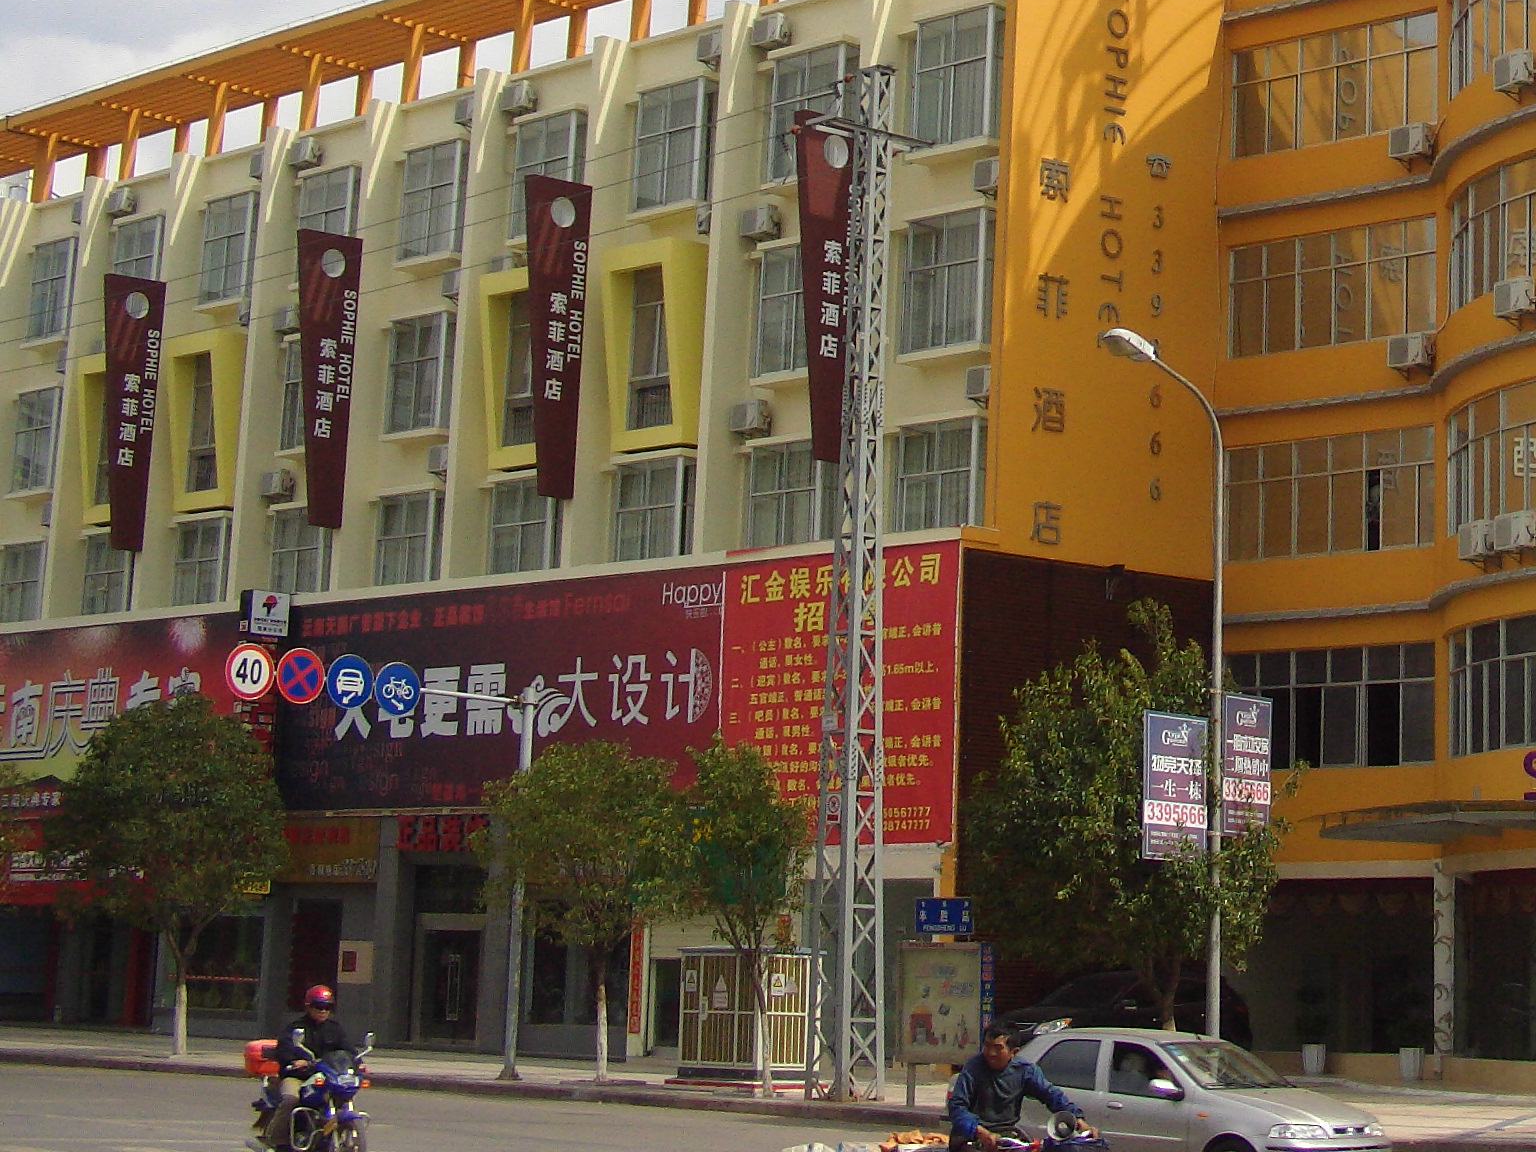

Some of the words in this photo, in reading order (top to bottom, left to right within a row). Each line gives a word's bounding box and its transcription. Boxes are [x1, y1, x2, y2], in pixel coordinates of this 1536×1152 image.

[571, 239, 587, 301] SOPHIE
[1097, 194, 1124, 348] HOTE
[340, 289, 358, 345] SOPHIE
[818, 239, 843, 359] 索菲酒店
[144, 329, 161, 382] SOPHIE
[542, 291, 568, 402] 索菲酒店
[567, 309, 583, 363] HOTEL
[1030, 158, 1070, 546] 索菲酒店
[313, 337, 338, 439] 索菲酒店
[336, 353, 352, 403] HOTEL
[116, 372, 141, 468] 索菲酒店
[139, 388, 156, 435] HOTEL
[662, 582, 722, 608] Happy
[235, 657, 263, 685] 40
[1146, 801, 1206, 826] 3395666
